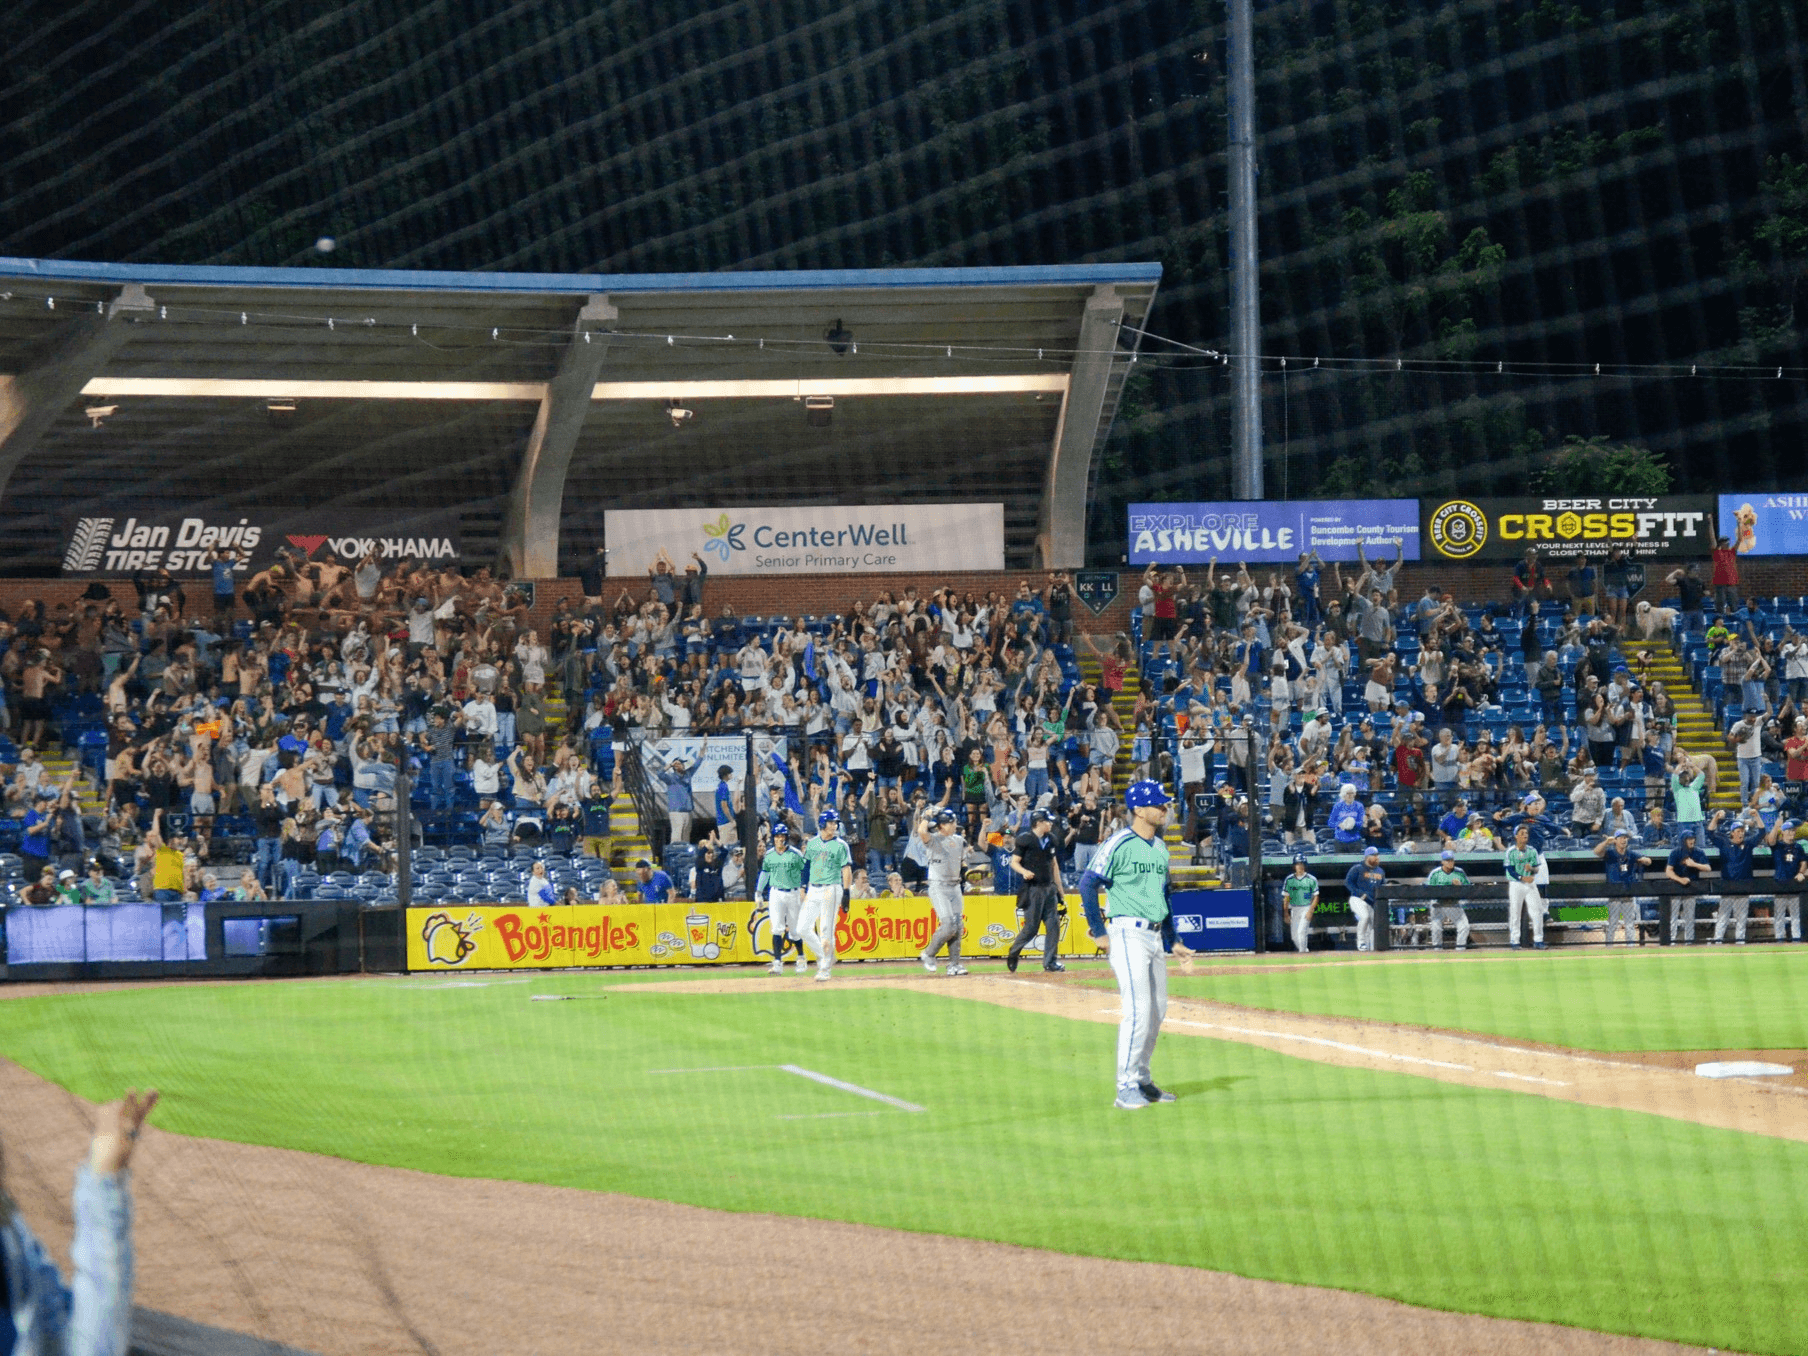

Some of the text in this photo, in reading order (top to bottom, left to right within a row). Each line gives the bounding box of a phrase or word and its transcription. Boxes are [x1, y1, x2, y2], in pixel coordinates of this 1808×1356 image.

[1542, 498, 1658, 510] BEER CITY
[1129, 513, 1259, 533] EXPLORE
[1311, 524, 1419, 535] Buncombe County Tourism
[1434, 504, 1484, 540] BEER CITY CROSSFIT
[1499, 511, 1704, 539] CROSSFIT
[111, 518, 262, 548] Jan Davis
[753, 523, 908, 548] CenterWell
[1134, 527, 1294, 553] ASHEVILLE
[1311, 536, 1403, 547] Developme Authori
[327, 537, 456, 559] YOKOHAMA
[105, 550, 253, 571] TIRE STOE
[755, 553, 897, 568] Senior Primary Care
[1080, 582, 1094, 591] KK
[1102, 582, 1113, 591] LL
[493, 911, 638, 962] Bojangles
[835, 904, 967, 954] Bojangl
